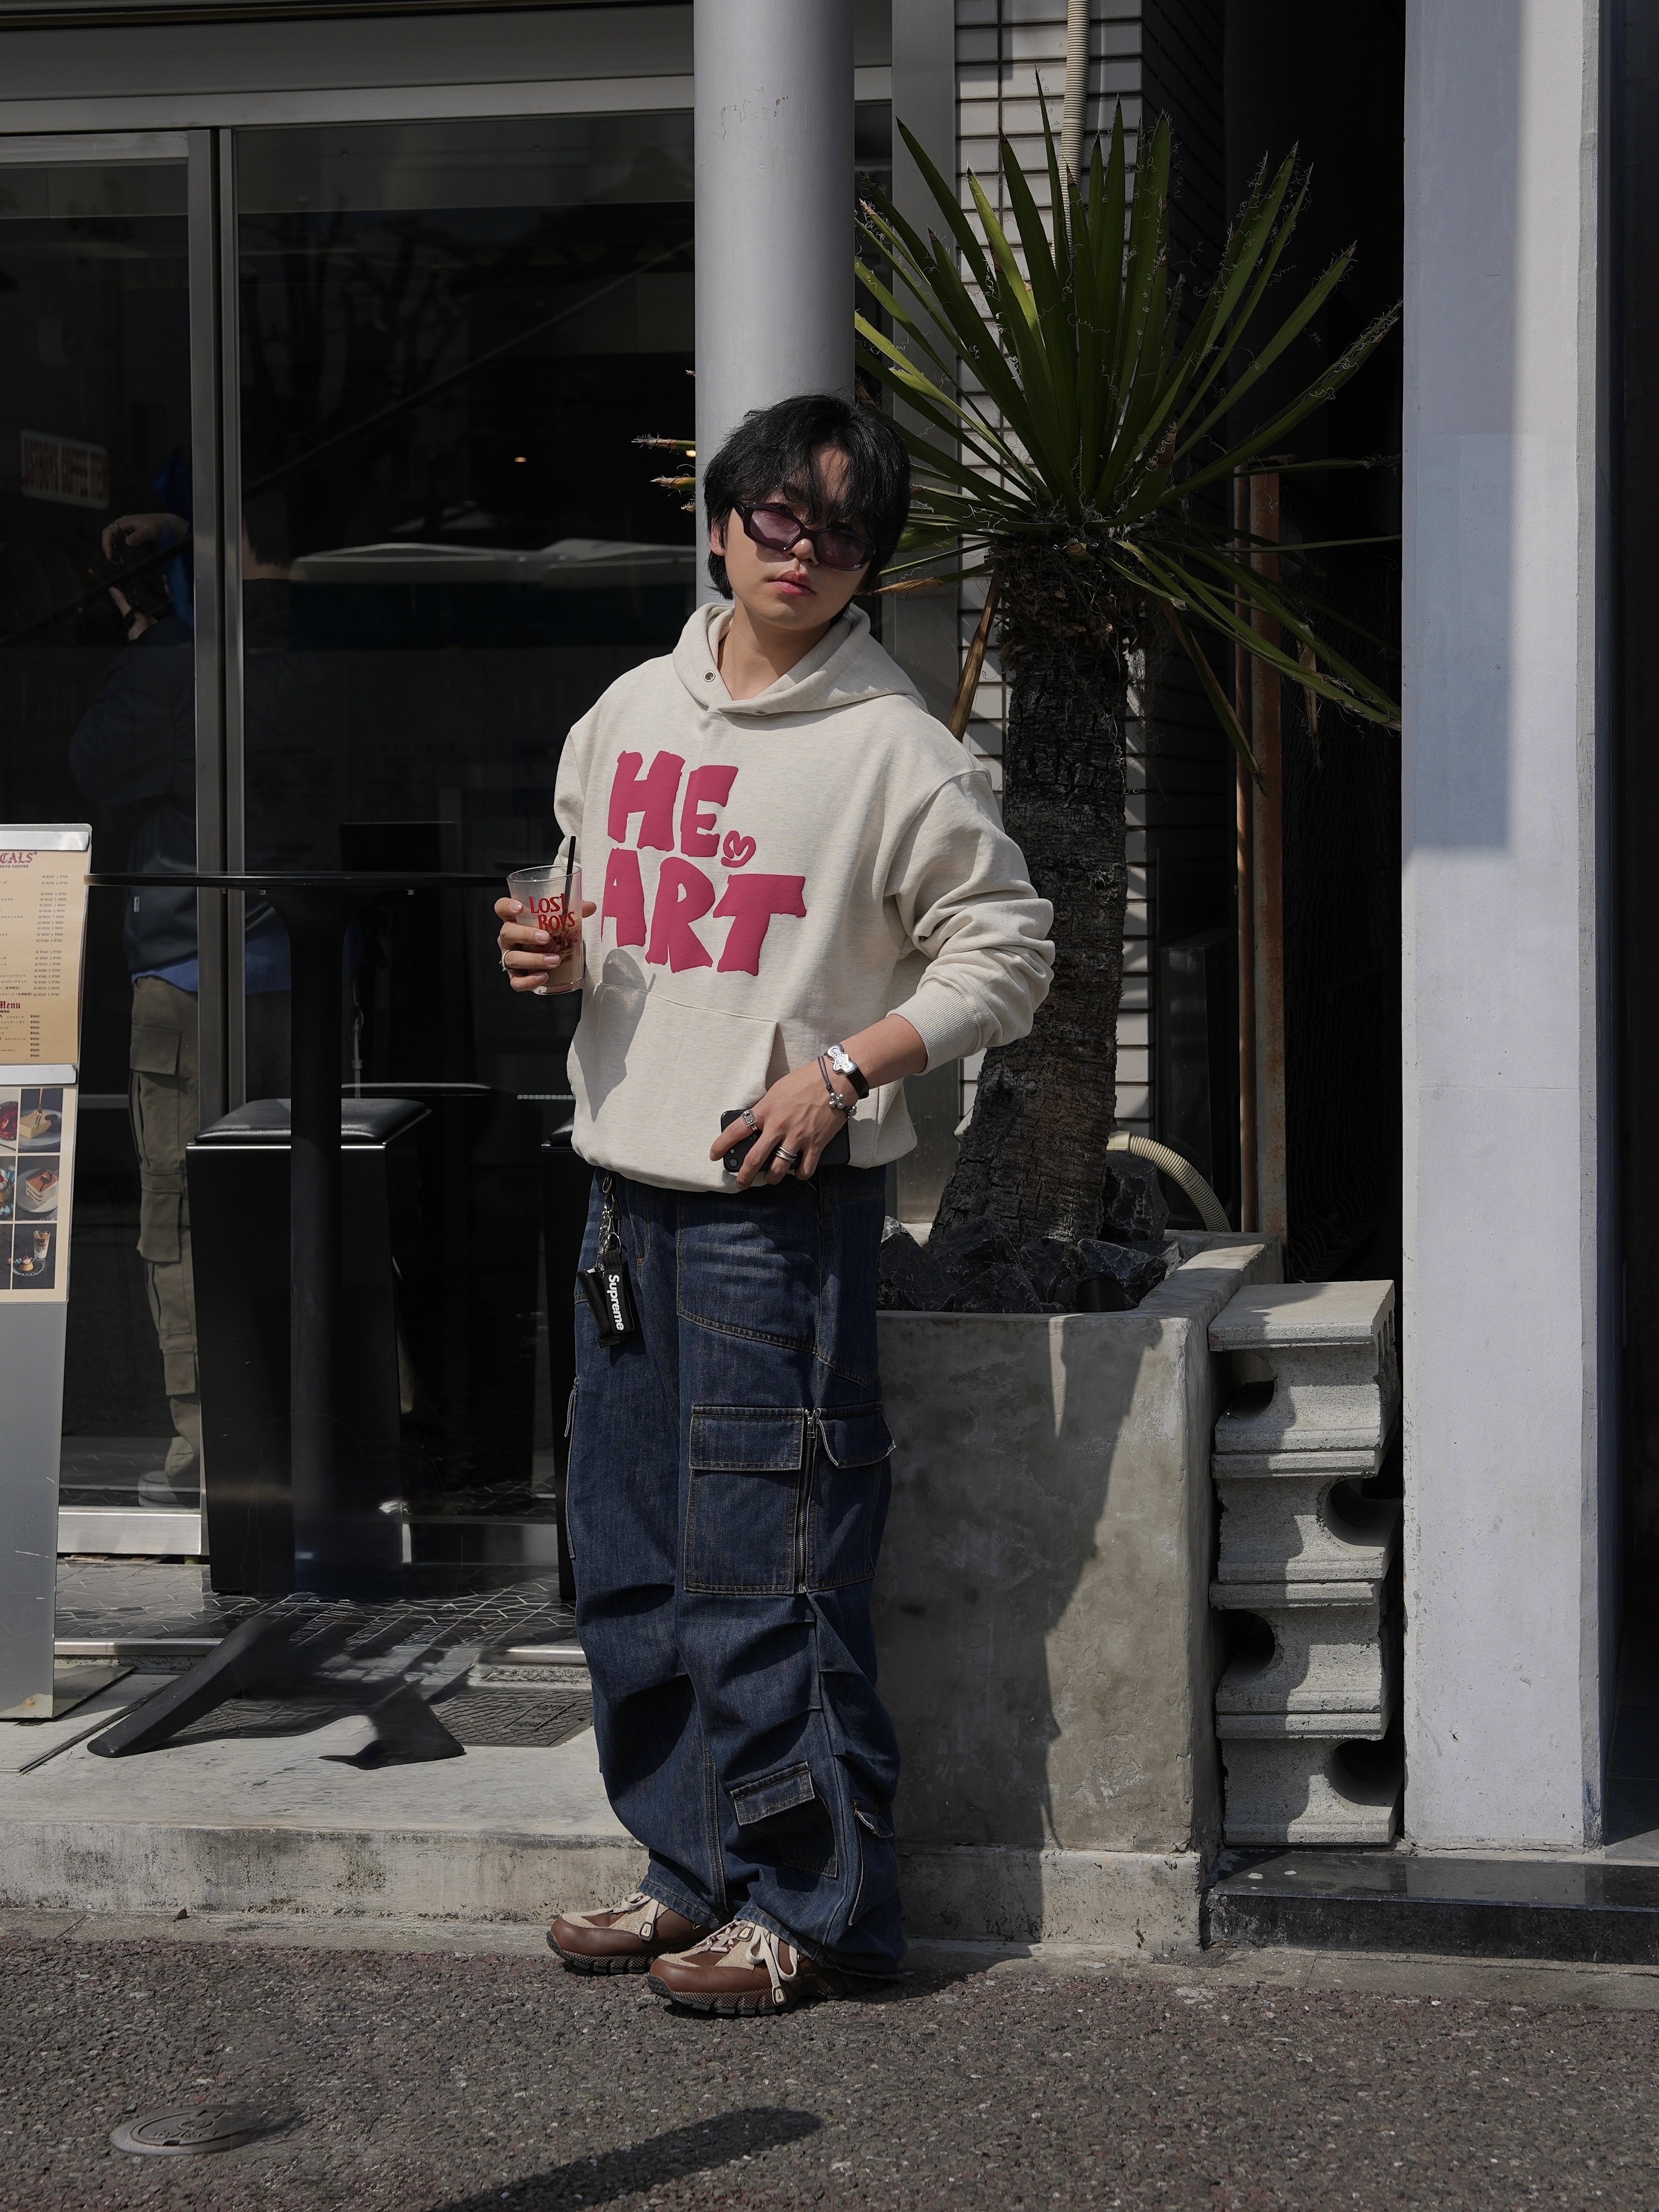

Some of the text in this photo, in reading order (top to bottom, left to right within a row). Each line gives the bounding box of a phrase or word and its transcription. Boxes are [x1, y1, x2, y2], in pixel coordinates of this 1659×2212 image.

[608, 750, 738, 857] HE
[529, 893, 567, 913] LOST
[537, 911, 575, 931] BOYS
[601, 848, 807, 976] ART
[607, 1274, 624, 1330] Supreme
